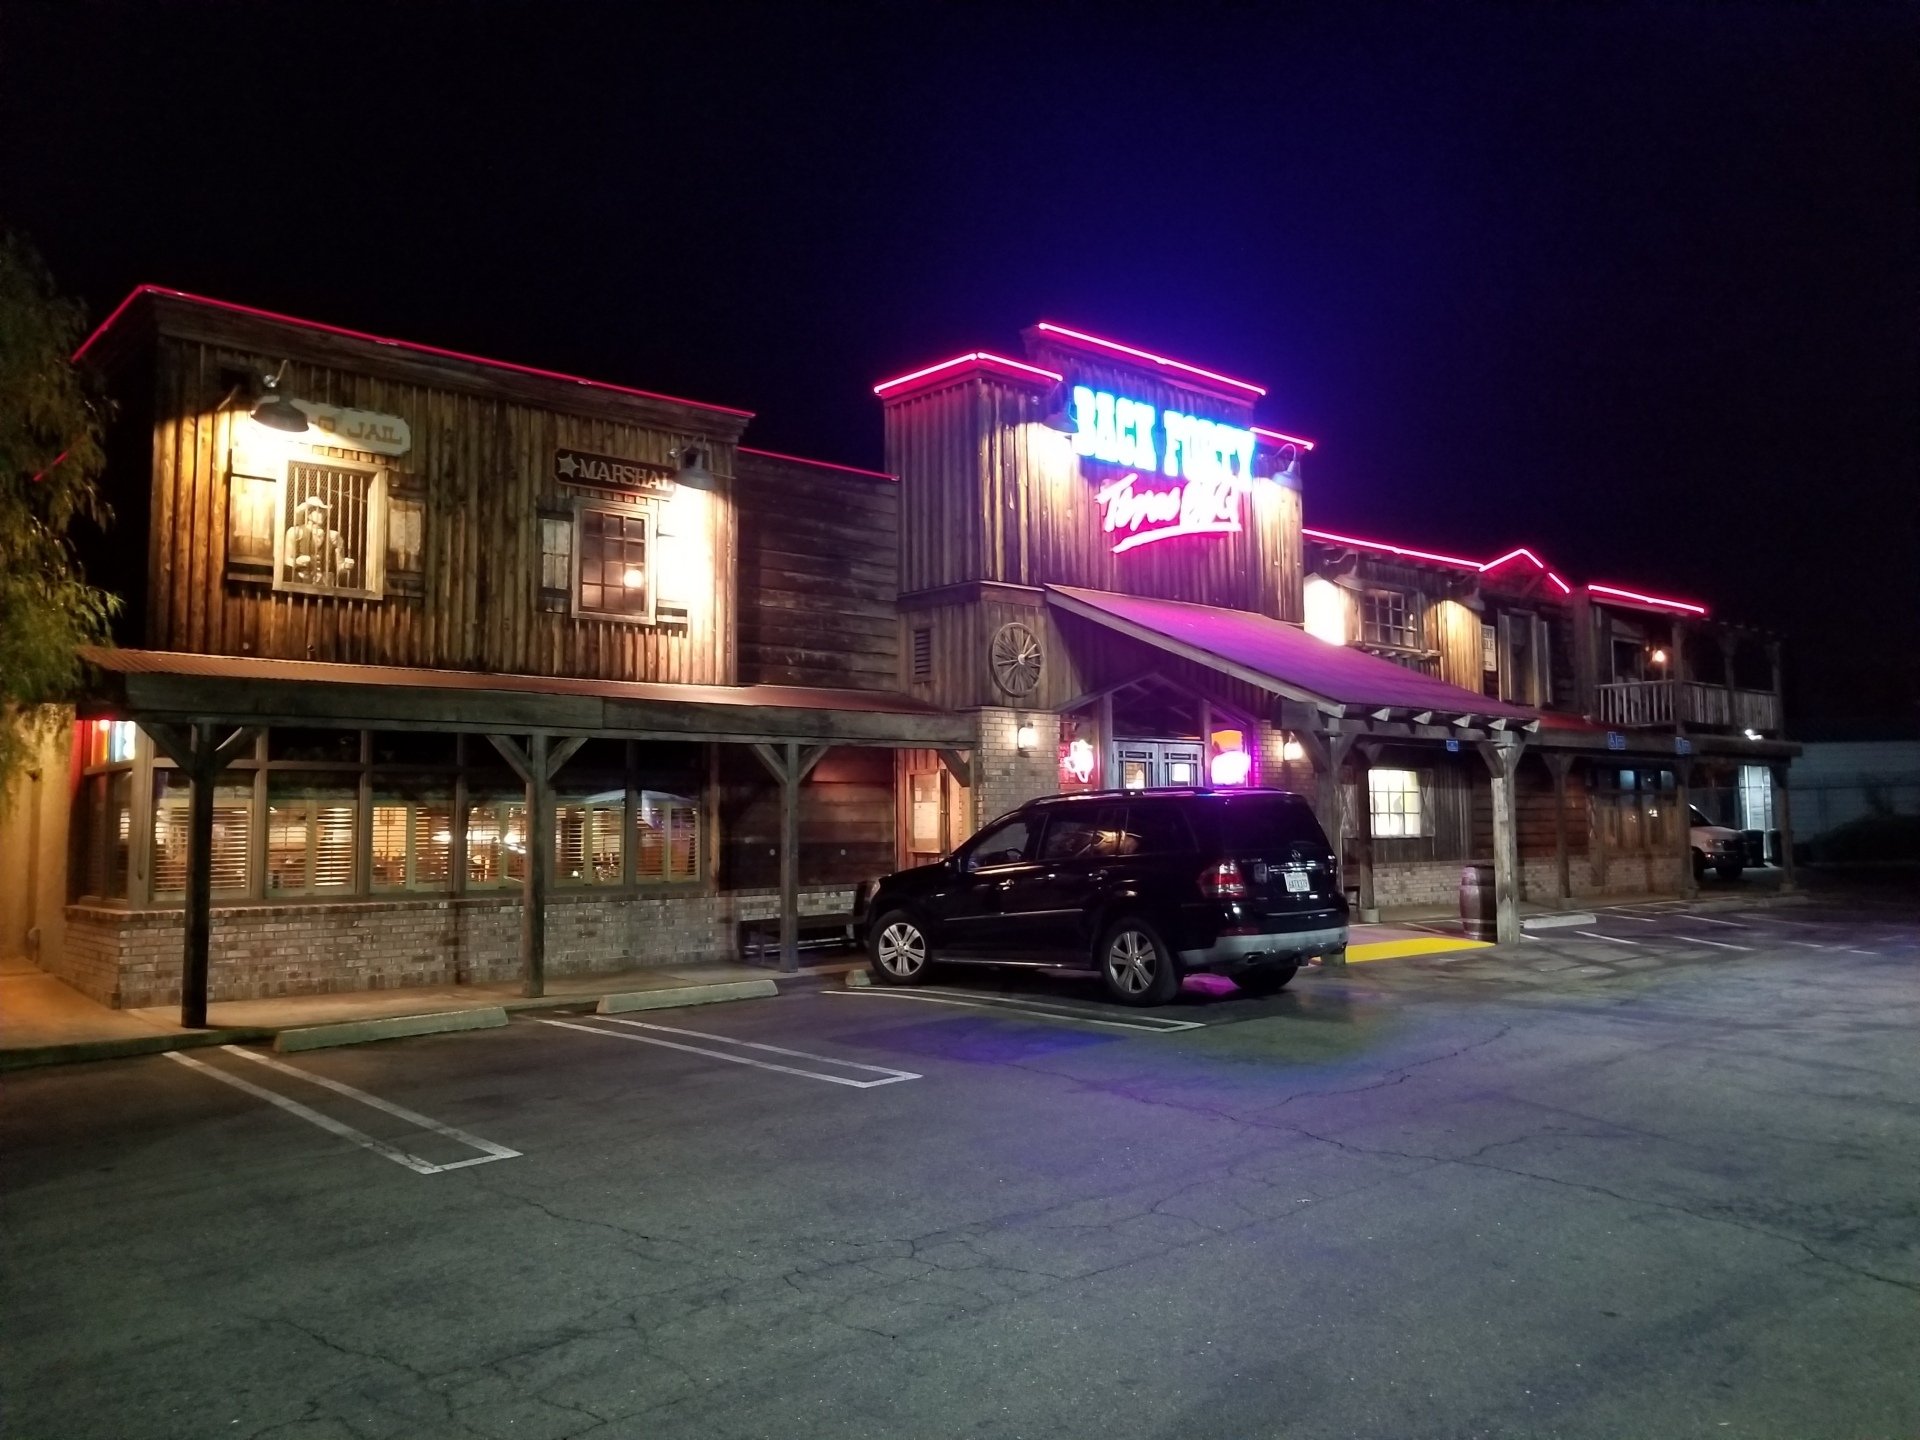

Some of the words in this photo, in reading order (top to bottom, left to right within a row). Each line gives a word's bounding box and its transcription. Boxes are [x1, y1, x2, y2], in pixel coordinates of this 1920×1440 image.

[346, 421, 403, 446] JAIL
[1072, 385, 1157, 472] BACK
[1163, 410, 1256, 491] FORTY
[579, 458, 675, 491] MARSHAL
